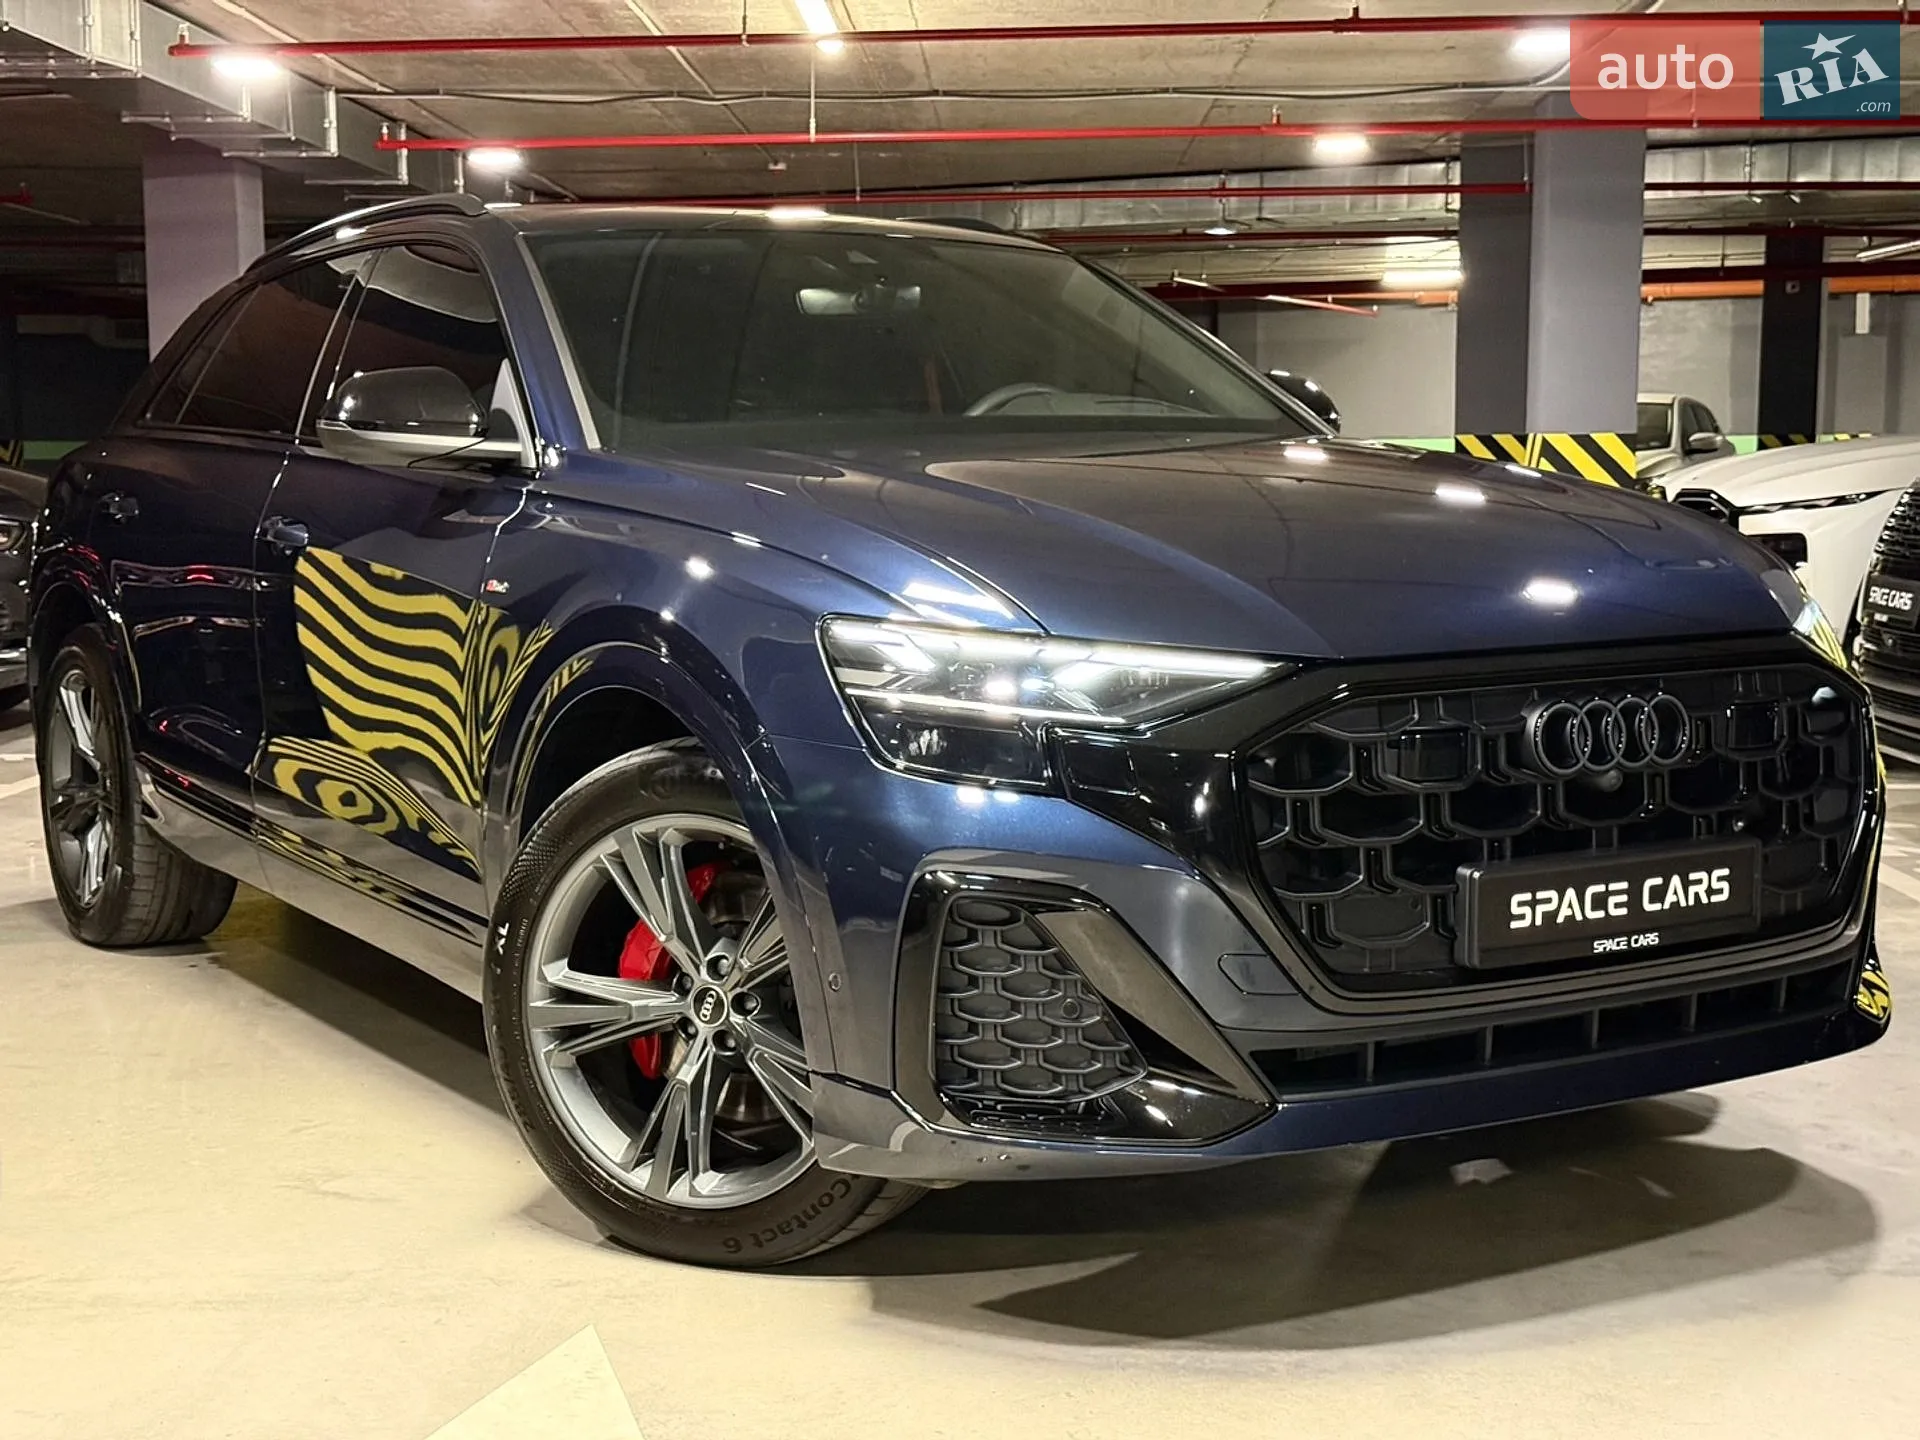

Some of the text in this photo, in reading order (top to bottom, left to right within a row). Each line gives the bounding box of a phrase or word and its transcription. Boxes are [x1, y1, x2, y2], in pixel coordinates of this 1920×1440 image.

[1887, 589, 1914, 611] CARS
[1509, 868, 1730, 929] SPACE CARS
[1593, 932, 1660, 954] SPACE CARS
[722, 1236, 743, 1254] 6
